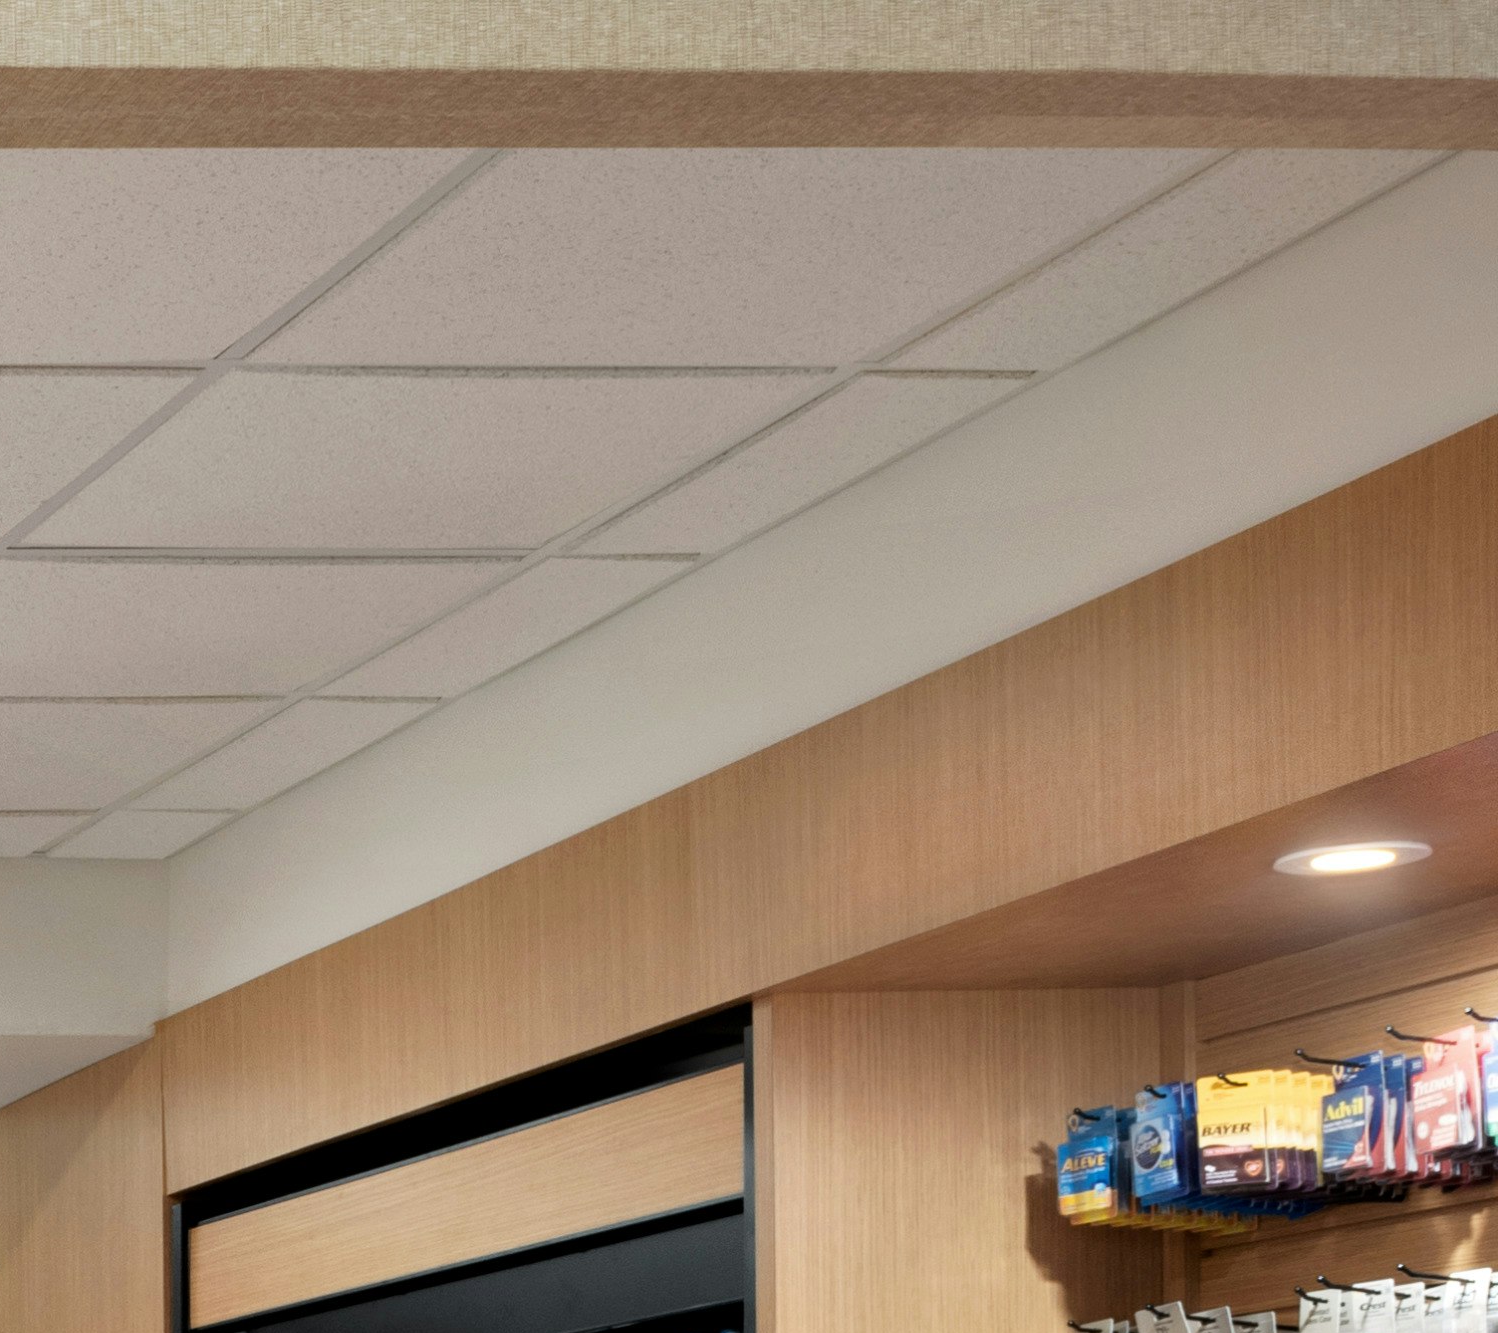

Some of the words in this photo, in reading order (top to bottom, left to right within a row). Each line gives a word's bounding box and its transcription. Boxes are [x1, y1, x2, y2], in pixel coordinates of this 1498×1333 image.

[1325, 1097, 1364, 1121] Advil
[1201, 1122, 1252, 1138] BAYER
[1061, 1153, 1106, 1174] ALEVE
[1398, 1304, 1416, 1314] rest
